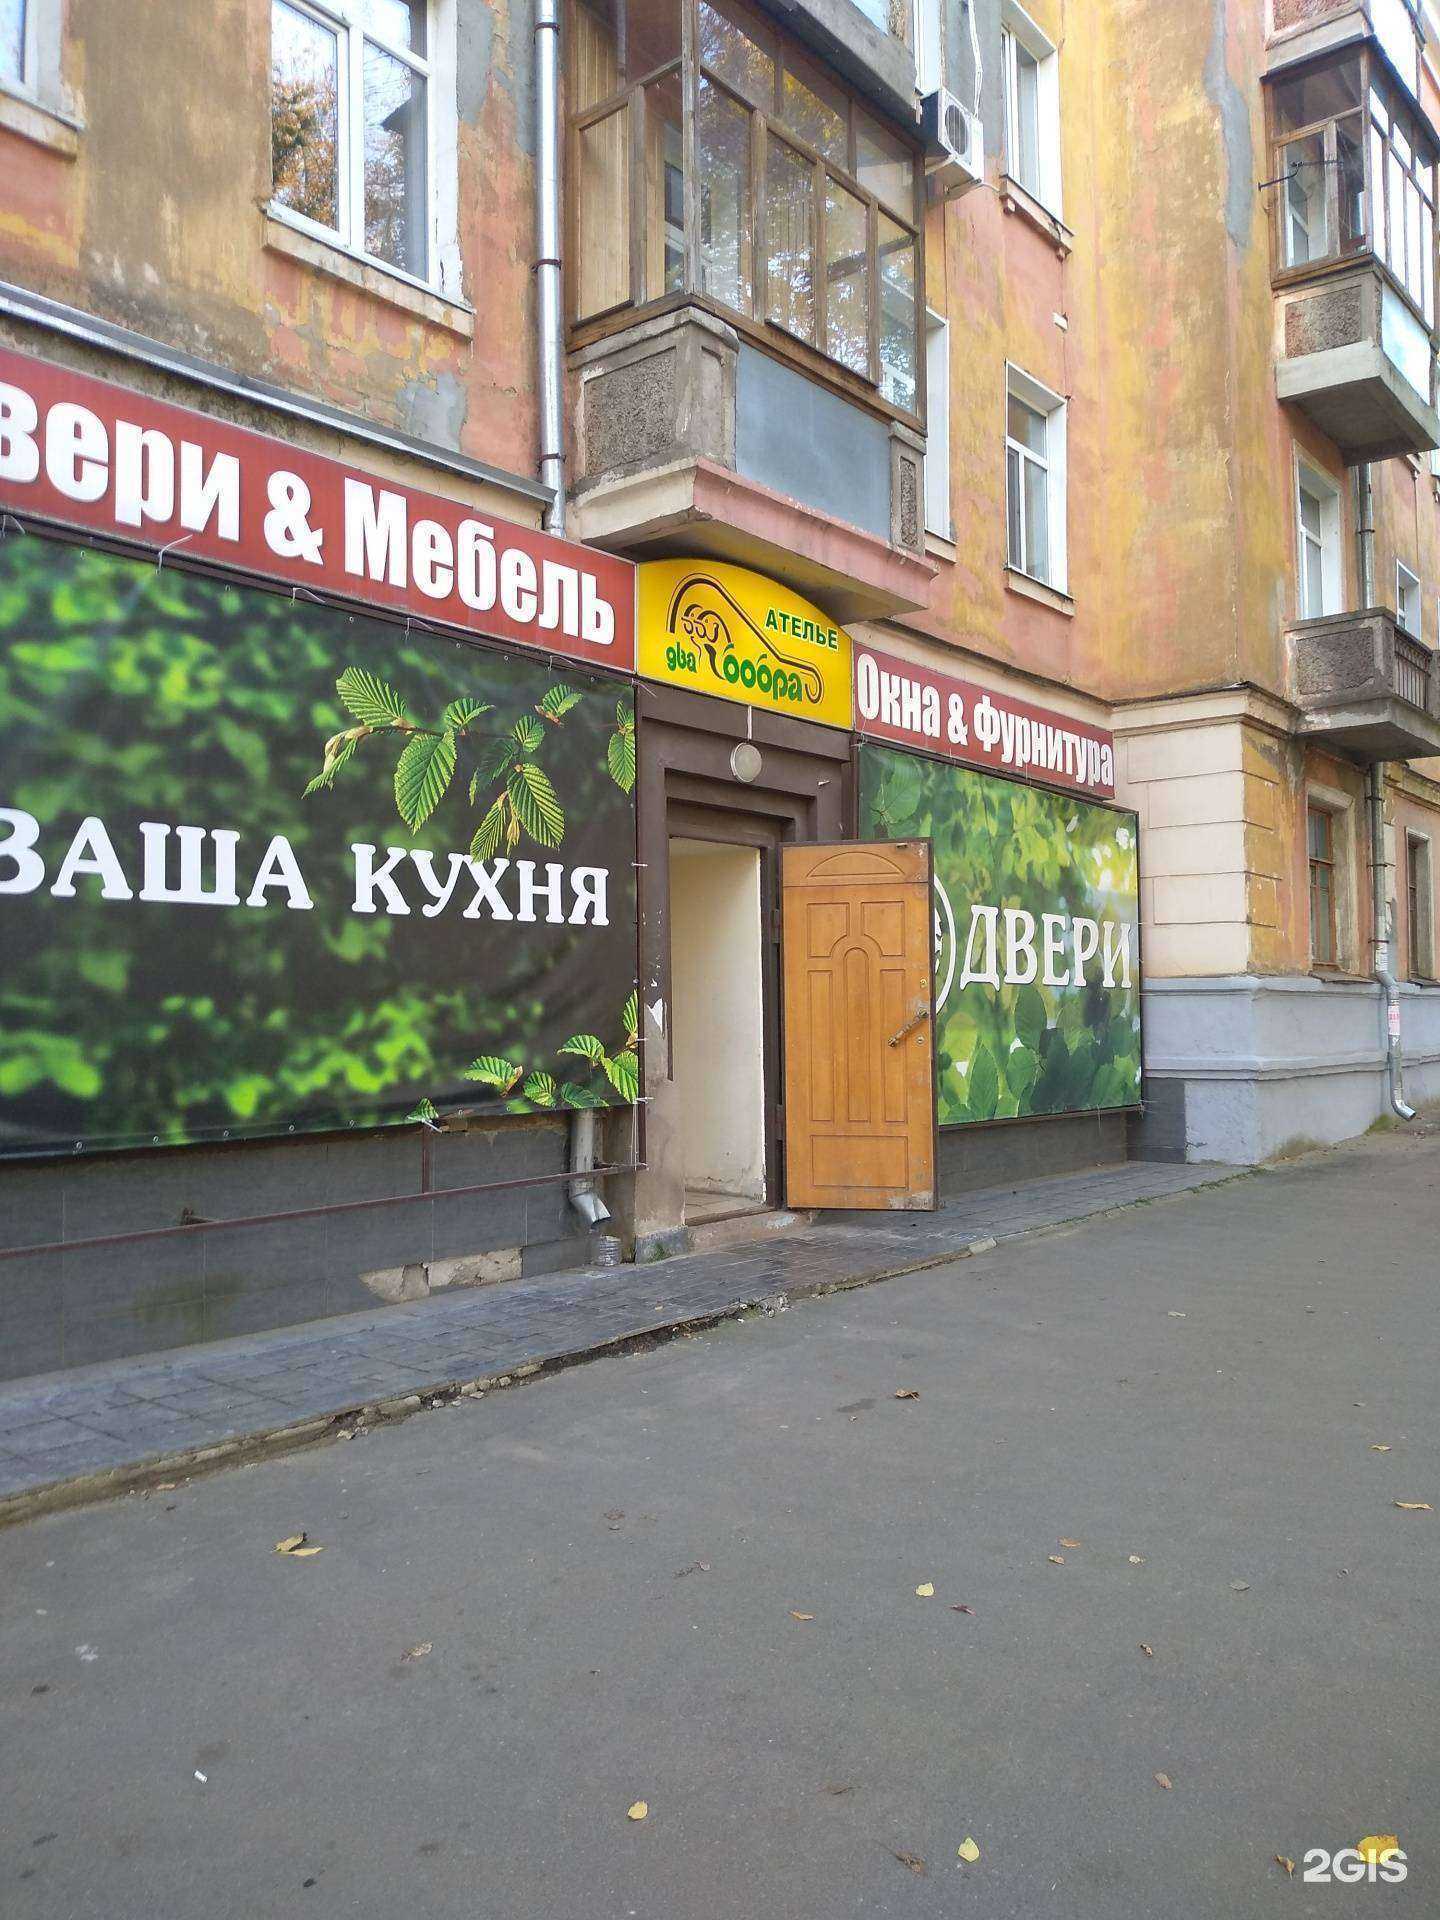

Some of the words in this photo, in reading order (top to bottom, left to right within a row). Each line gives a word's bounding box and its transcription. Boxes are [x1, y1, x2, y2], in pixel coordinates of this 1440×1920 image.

[263, 469, 325, 567] &
[343, 476, 617, 646] Мебель
[722, 642, 803, 703] бобра
[765, 609, 838, 650] АТЕЛЬЕ
[856, 652, 941, 738] Окна
[947, 692, 969, 747] &
[973, 694, 1114, 787] Фурнитура
[0, 807, 314, 910] ВАША
[350, 842, 610, 926] КУХНЯ
[959, 904, 1133, 992] ДВЕРИ
